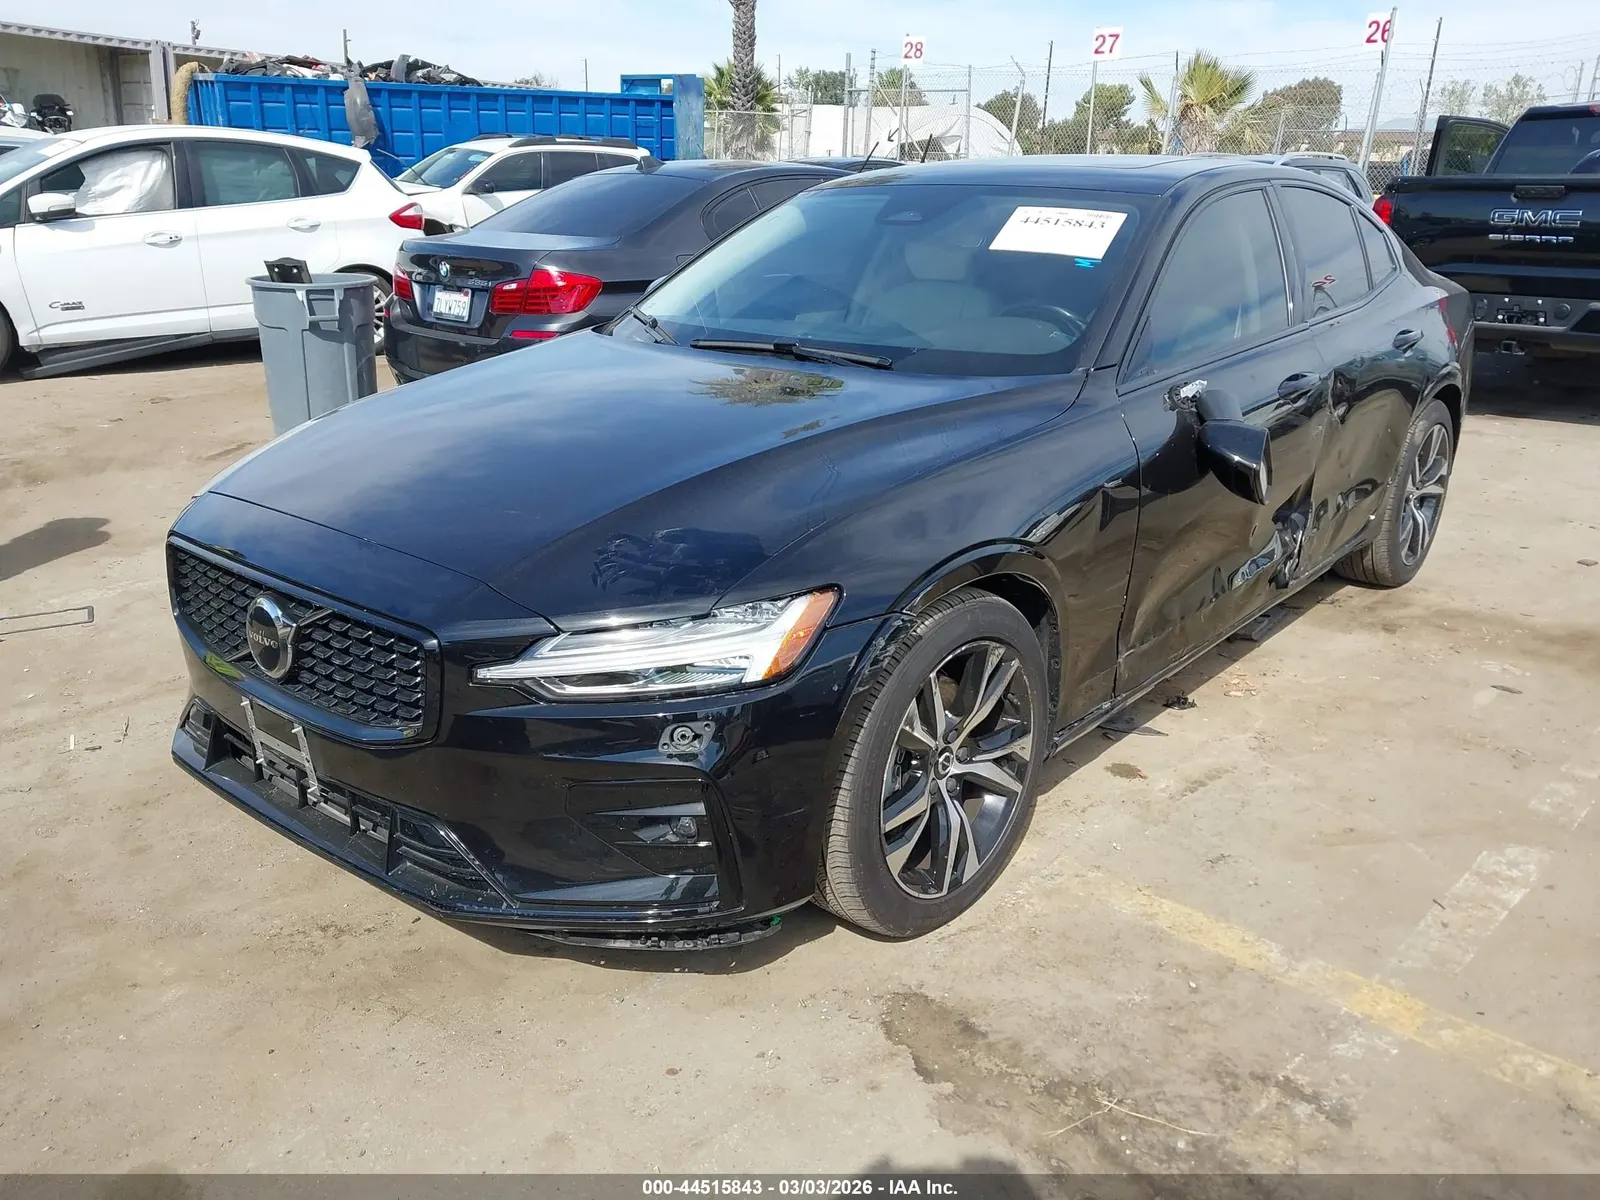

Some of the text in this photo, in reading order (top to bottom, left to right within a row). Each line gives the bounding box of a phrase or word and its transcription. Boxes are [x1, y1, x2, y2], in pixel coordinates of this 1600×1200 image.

[1365, 20, 1391, 43] 26
[903, 41, 924, 59] 28
[1093, 34, 1120, 54] 27
[1020, 216, 1106, 230] 44515843
[1490, 208, 1583, 227] GMC
[248, 629, 279, 649] VOLVO
